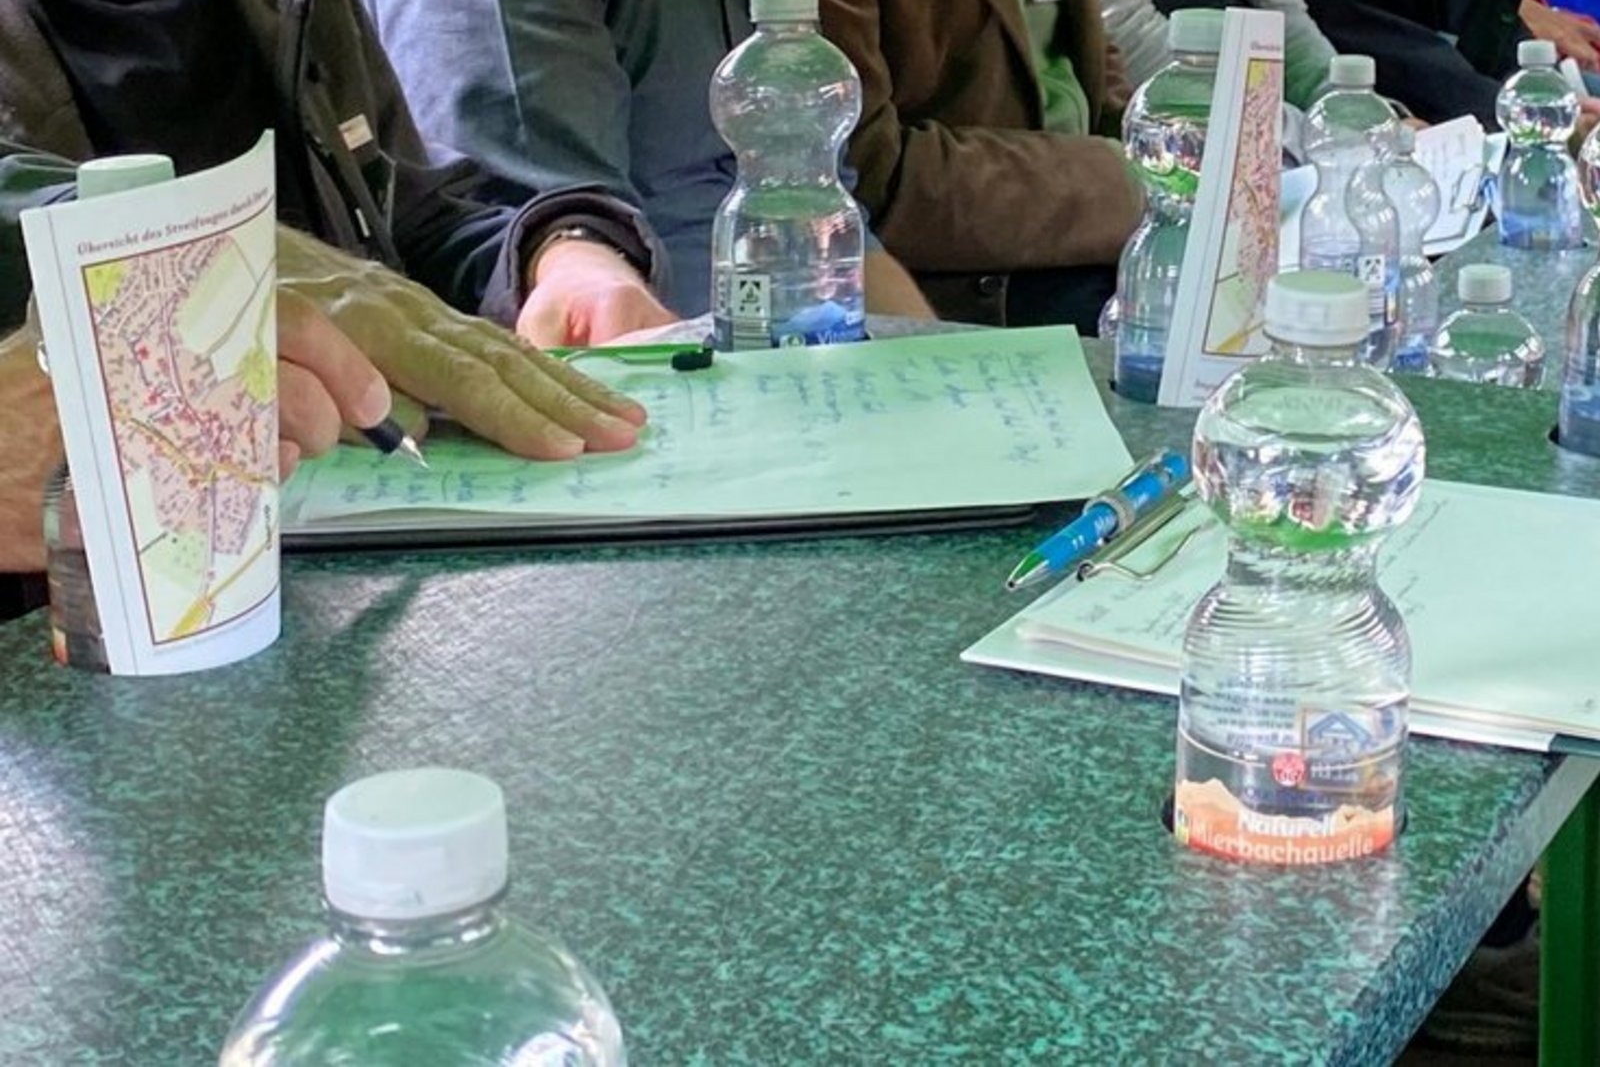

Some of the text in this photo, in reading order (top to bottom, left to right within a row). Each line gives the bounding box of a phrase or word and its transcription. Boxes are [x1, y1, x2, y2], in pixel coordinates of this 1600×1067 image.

[77, 233, 138, 255] Übersicht
[142, 227, 162, 242] des
[1237, 808, 1337, 839] Naturell
